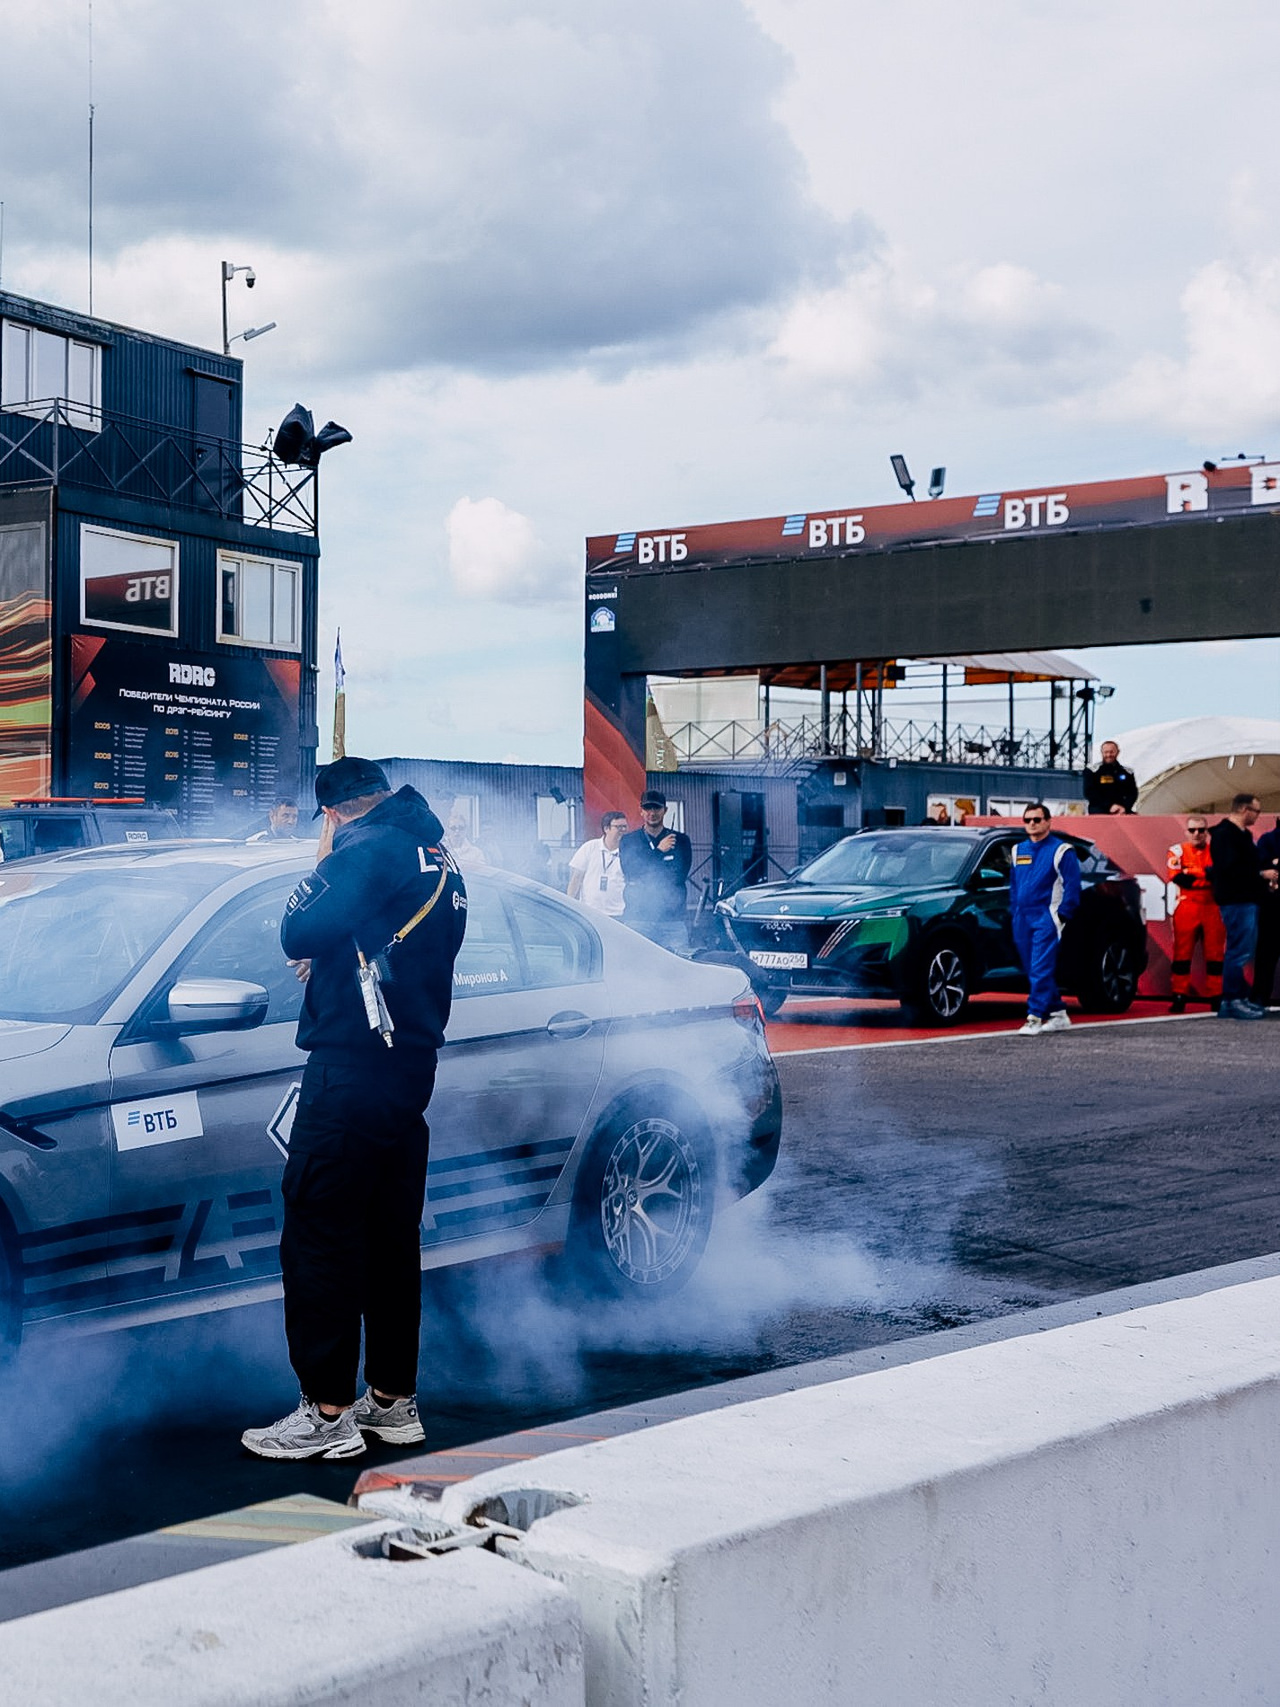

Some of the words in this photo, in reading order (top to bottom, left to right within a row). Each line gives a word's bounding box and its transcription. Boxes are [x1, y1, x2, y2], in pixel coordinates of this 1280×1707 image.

[1004, 493, 1070, 530] ВТБ
[808, 515, 865, 548] ВТБ
[638, 533, 688, 564] ВТБ
[169, 663, 216, 687] RDRC
[453, 972, 498, 987] Миронов
[500, 969, 509, 981] А
[144, 1109, 178, 1133] ВТБ
